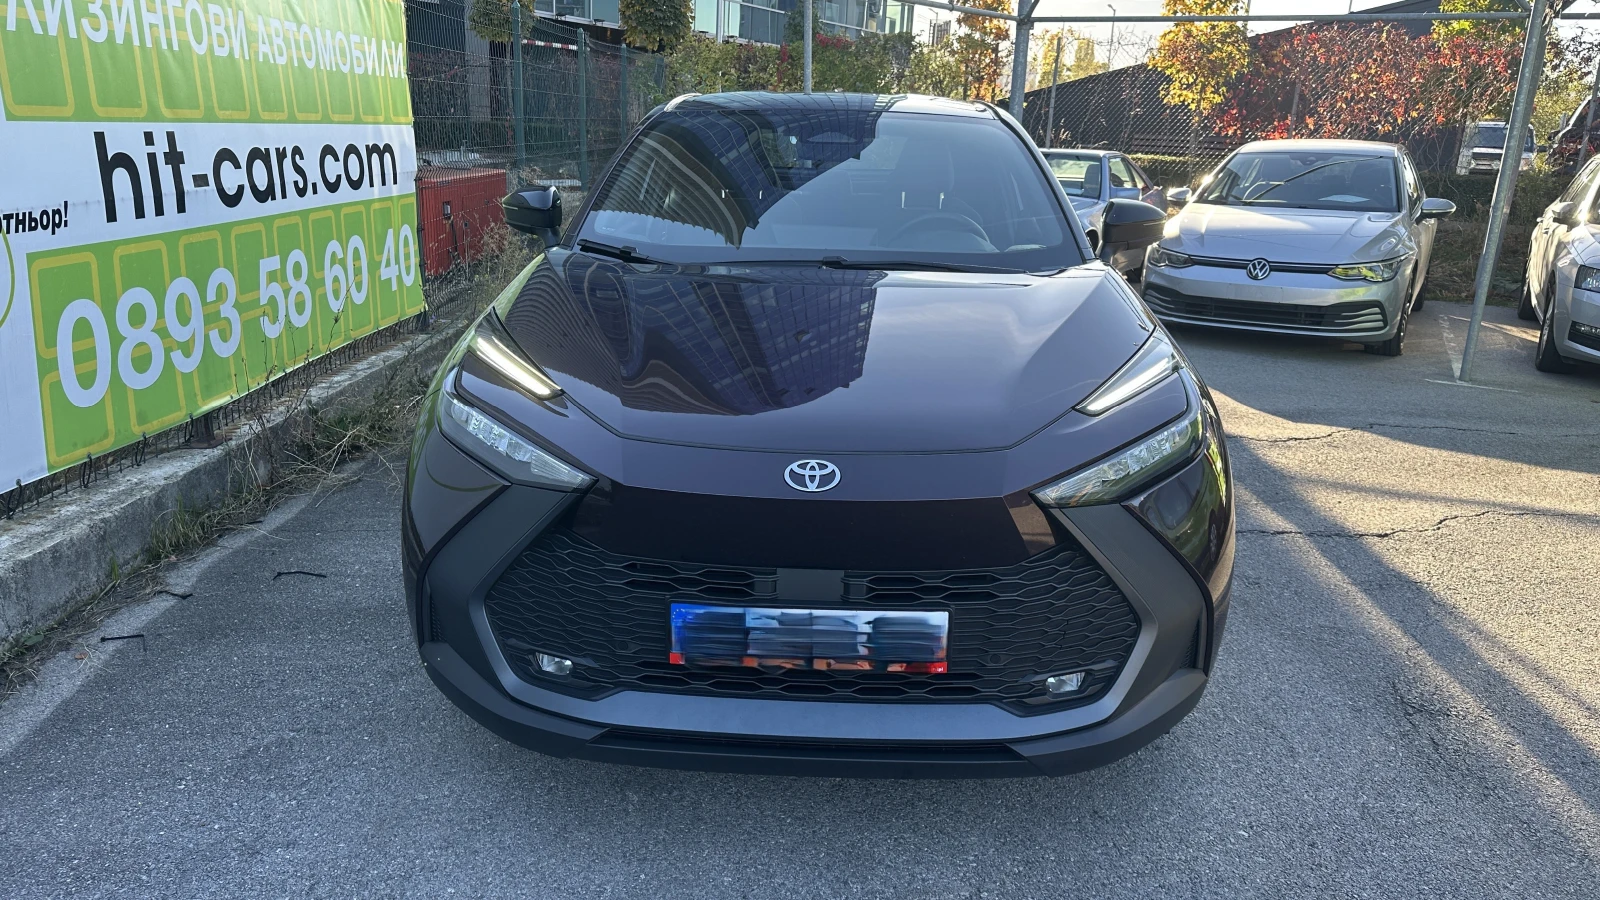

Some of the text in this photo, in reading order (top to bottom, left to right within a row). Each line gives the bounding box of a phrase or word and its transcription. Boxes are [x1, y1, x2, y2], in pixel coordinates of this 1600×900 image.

[258, 17, 405, 79] АВТОМОБИЛИ
[93, 130, 398, 223] hit-cars.com
[0, 200, 69, 235] тньор!
[56, 223, 415, 408] 0893 58 60 40
